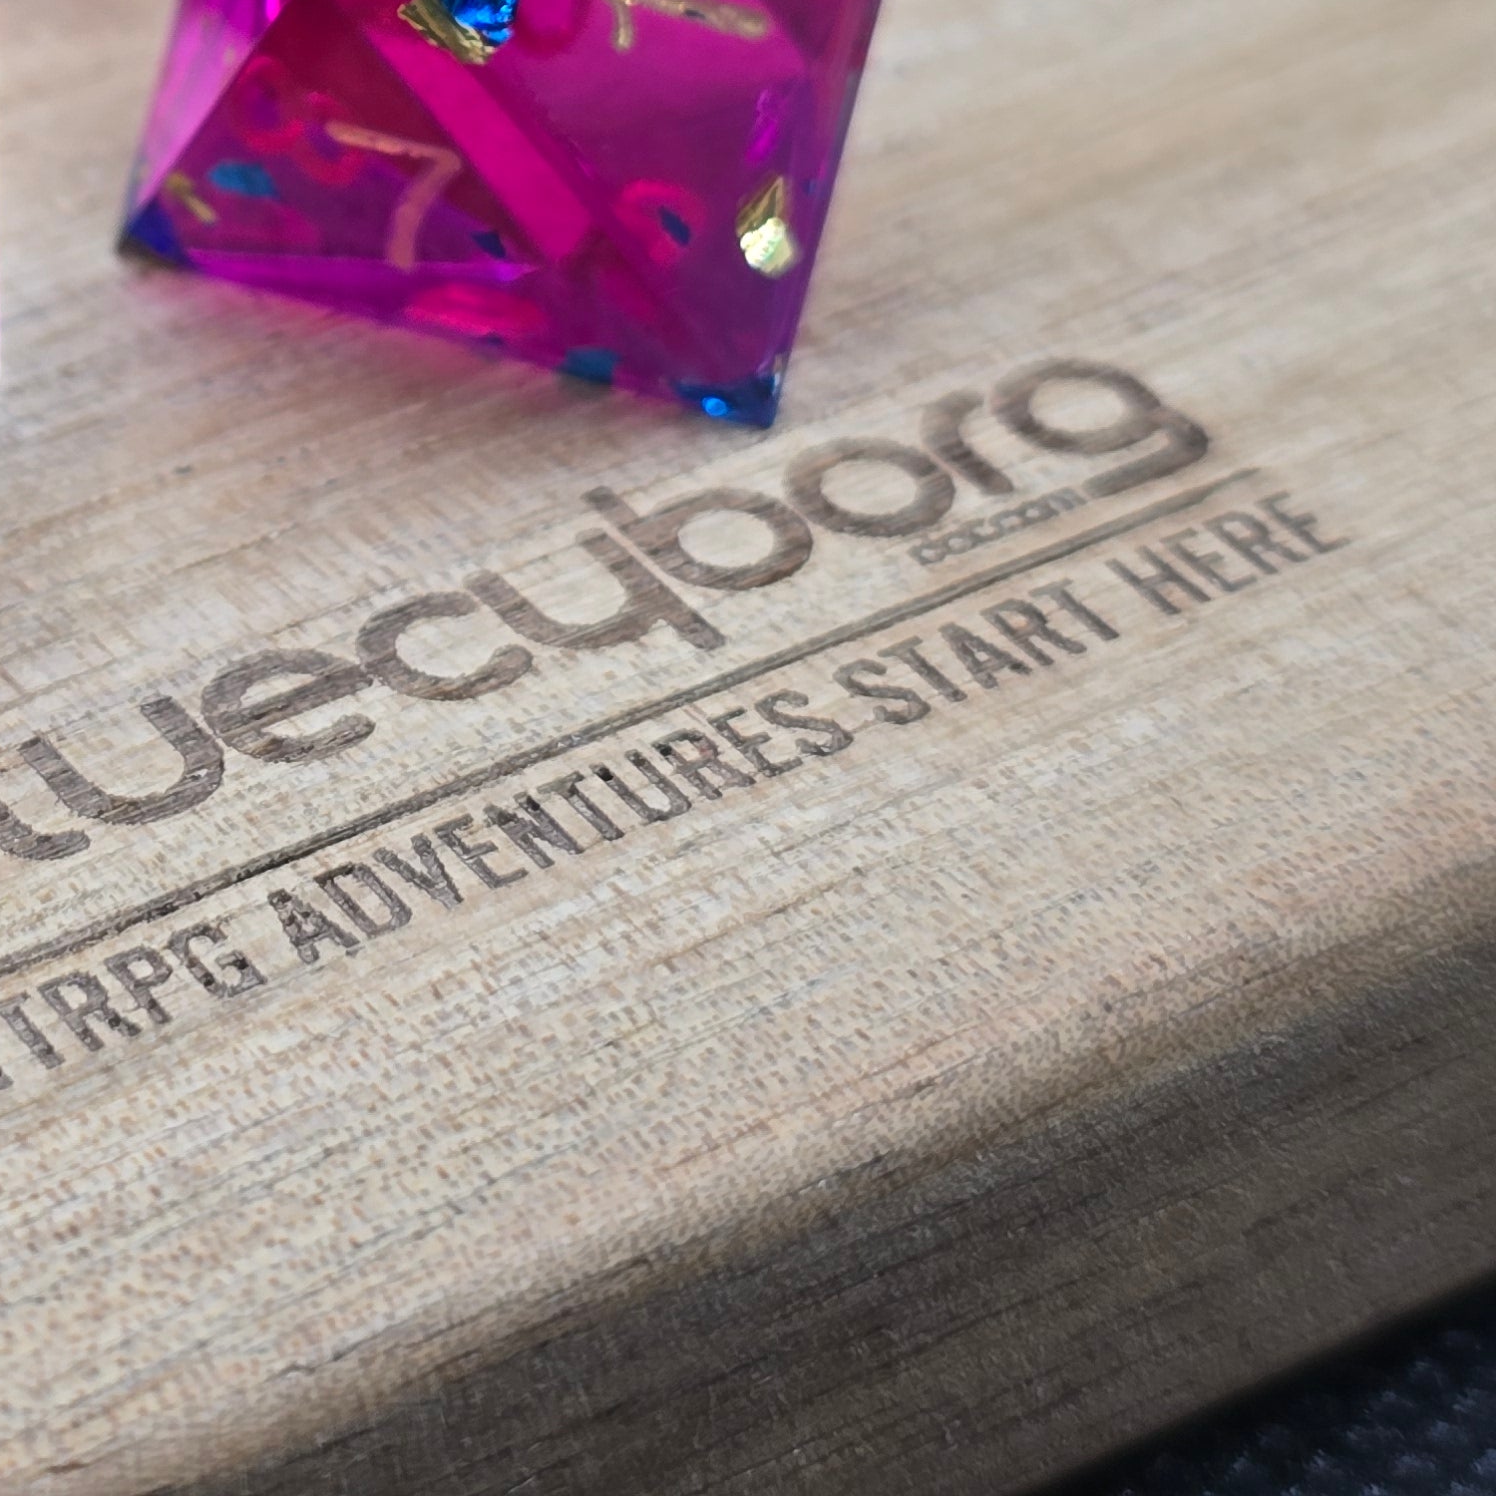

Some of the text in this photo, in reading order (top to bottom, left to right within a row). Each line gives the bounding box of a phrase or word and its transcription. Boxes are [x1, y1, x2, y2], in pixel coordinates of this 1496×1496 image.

[267, 689, 853, 965] ADVENTURES
[835, 578, 1122, 725] START
[1104, 491, 1349, 616] HERE
